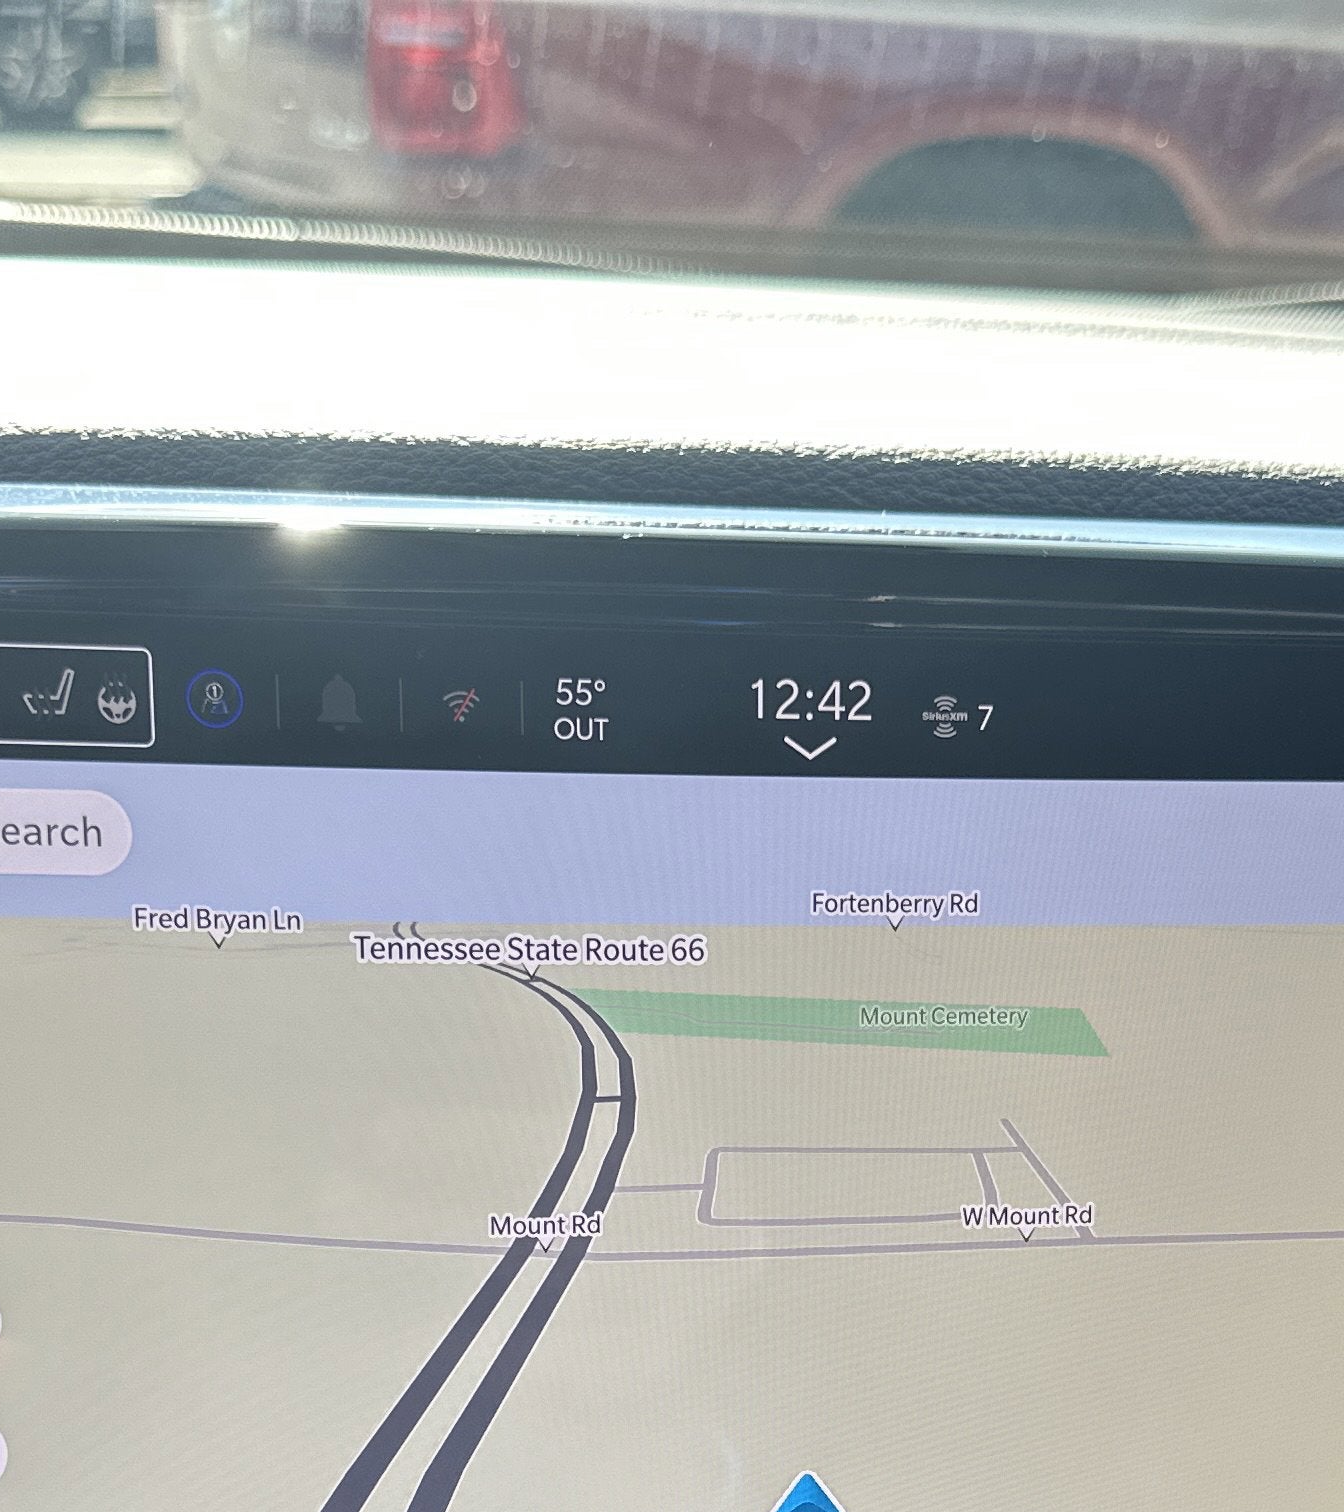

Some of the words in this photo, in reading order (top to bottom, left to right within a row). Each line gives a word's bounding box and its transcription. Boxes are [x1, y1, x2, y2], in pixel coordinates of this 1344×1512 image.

[556, 679, 607, 707] 55°
[751, 679, 872, 722] 12:42
[554, 717, 609, 742] OUT
[977, 704, 994, 731] 7
[811, 892, 944, 919] Fortenberry
[950, 893, 979, 914] Rd
[133, 907, 189, 931] Fred
[195, 908, 267, 936] Bryan
[272, 910, 302, 932] Ln
[354, 935, 500, 962] Tennessee
[507, 936, 578, 962] State
[586, 937, 664, 963] Route
[671, 937, 706, 962] 66
[860, 1007, 926, 1027] Mount
[931, 1007, 1029, 1031] Cemetery
[489, 1214, 565, 1237] Mount
[571, 1213, 601, 1235] Rd
[962, 1207, 982, 1226] W
[988, 1205, 1059, 1227] Mount
[1065, 1204, 1093, 1225] Rd
